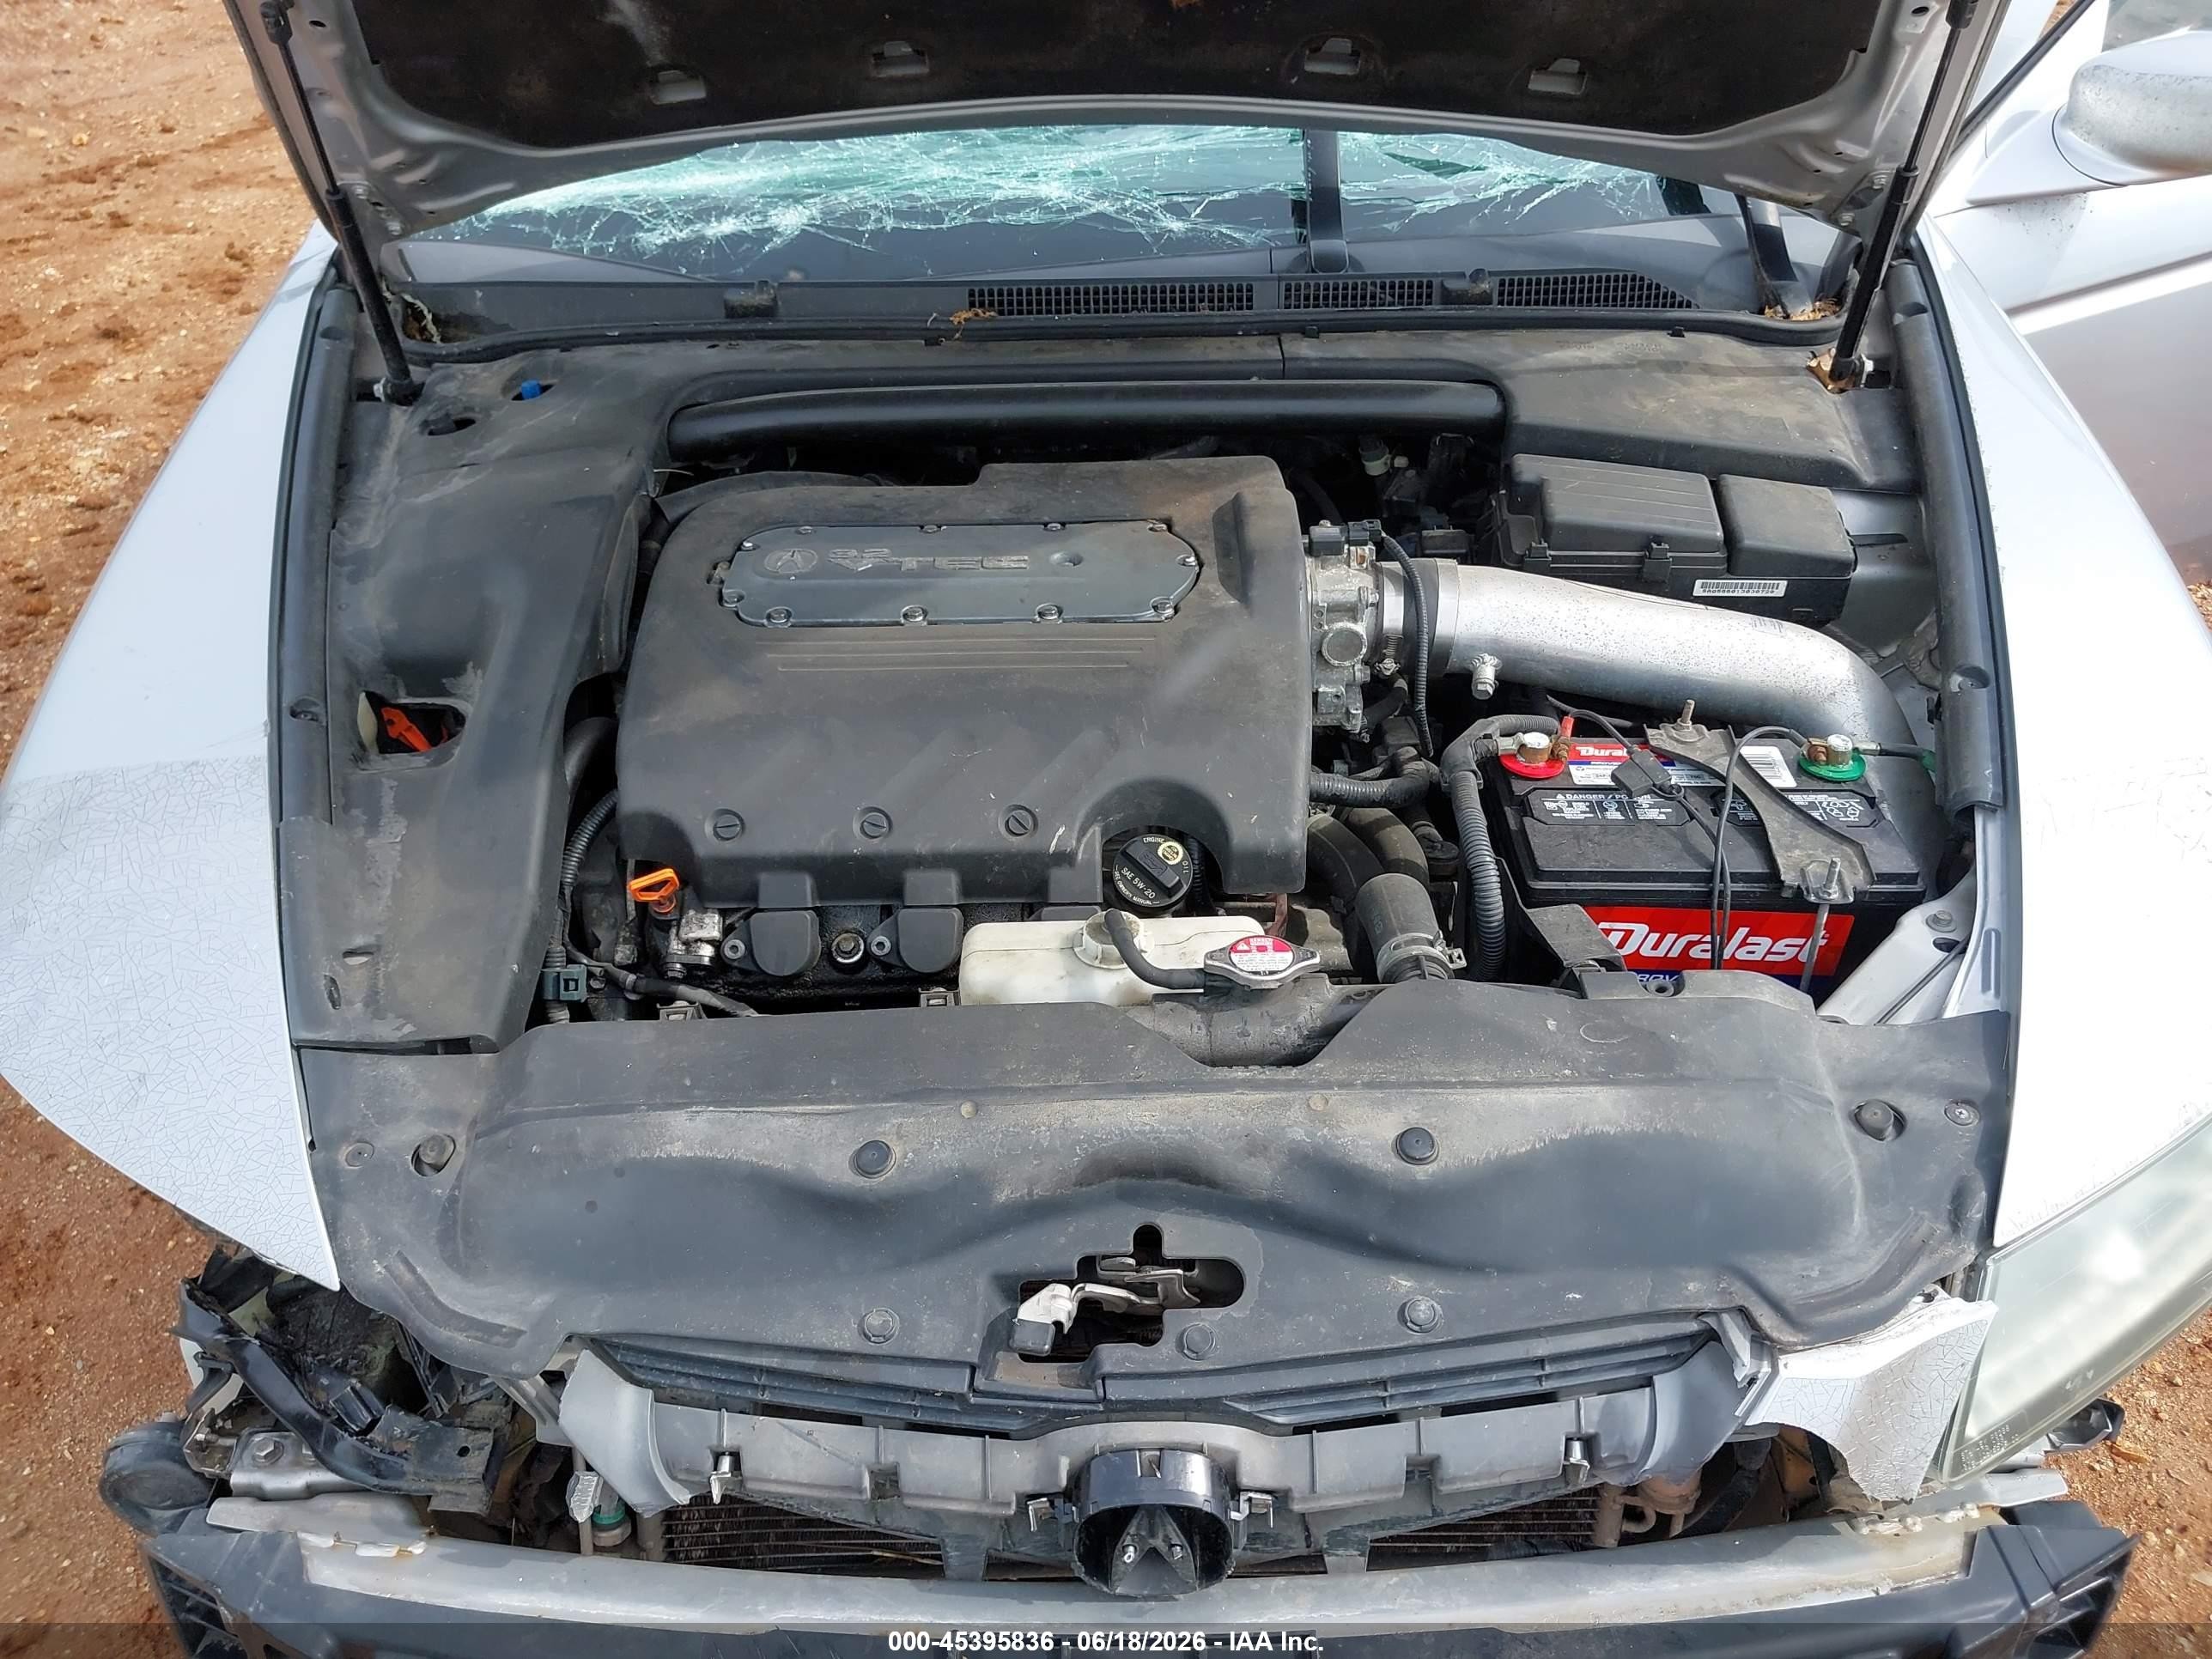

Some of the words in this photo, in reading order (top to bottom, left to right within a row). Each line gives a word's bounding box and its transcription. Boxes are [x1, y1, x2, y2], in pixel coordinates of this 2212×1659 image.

[1576, 745, 1628, 757] Dural
[1121, 866, 1134, 880] SAE
[1133, 878, 1156, 899] 5W-20
[1133, 896, 1152, 905] MANUAL
